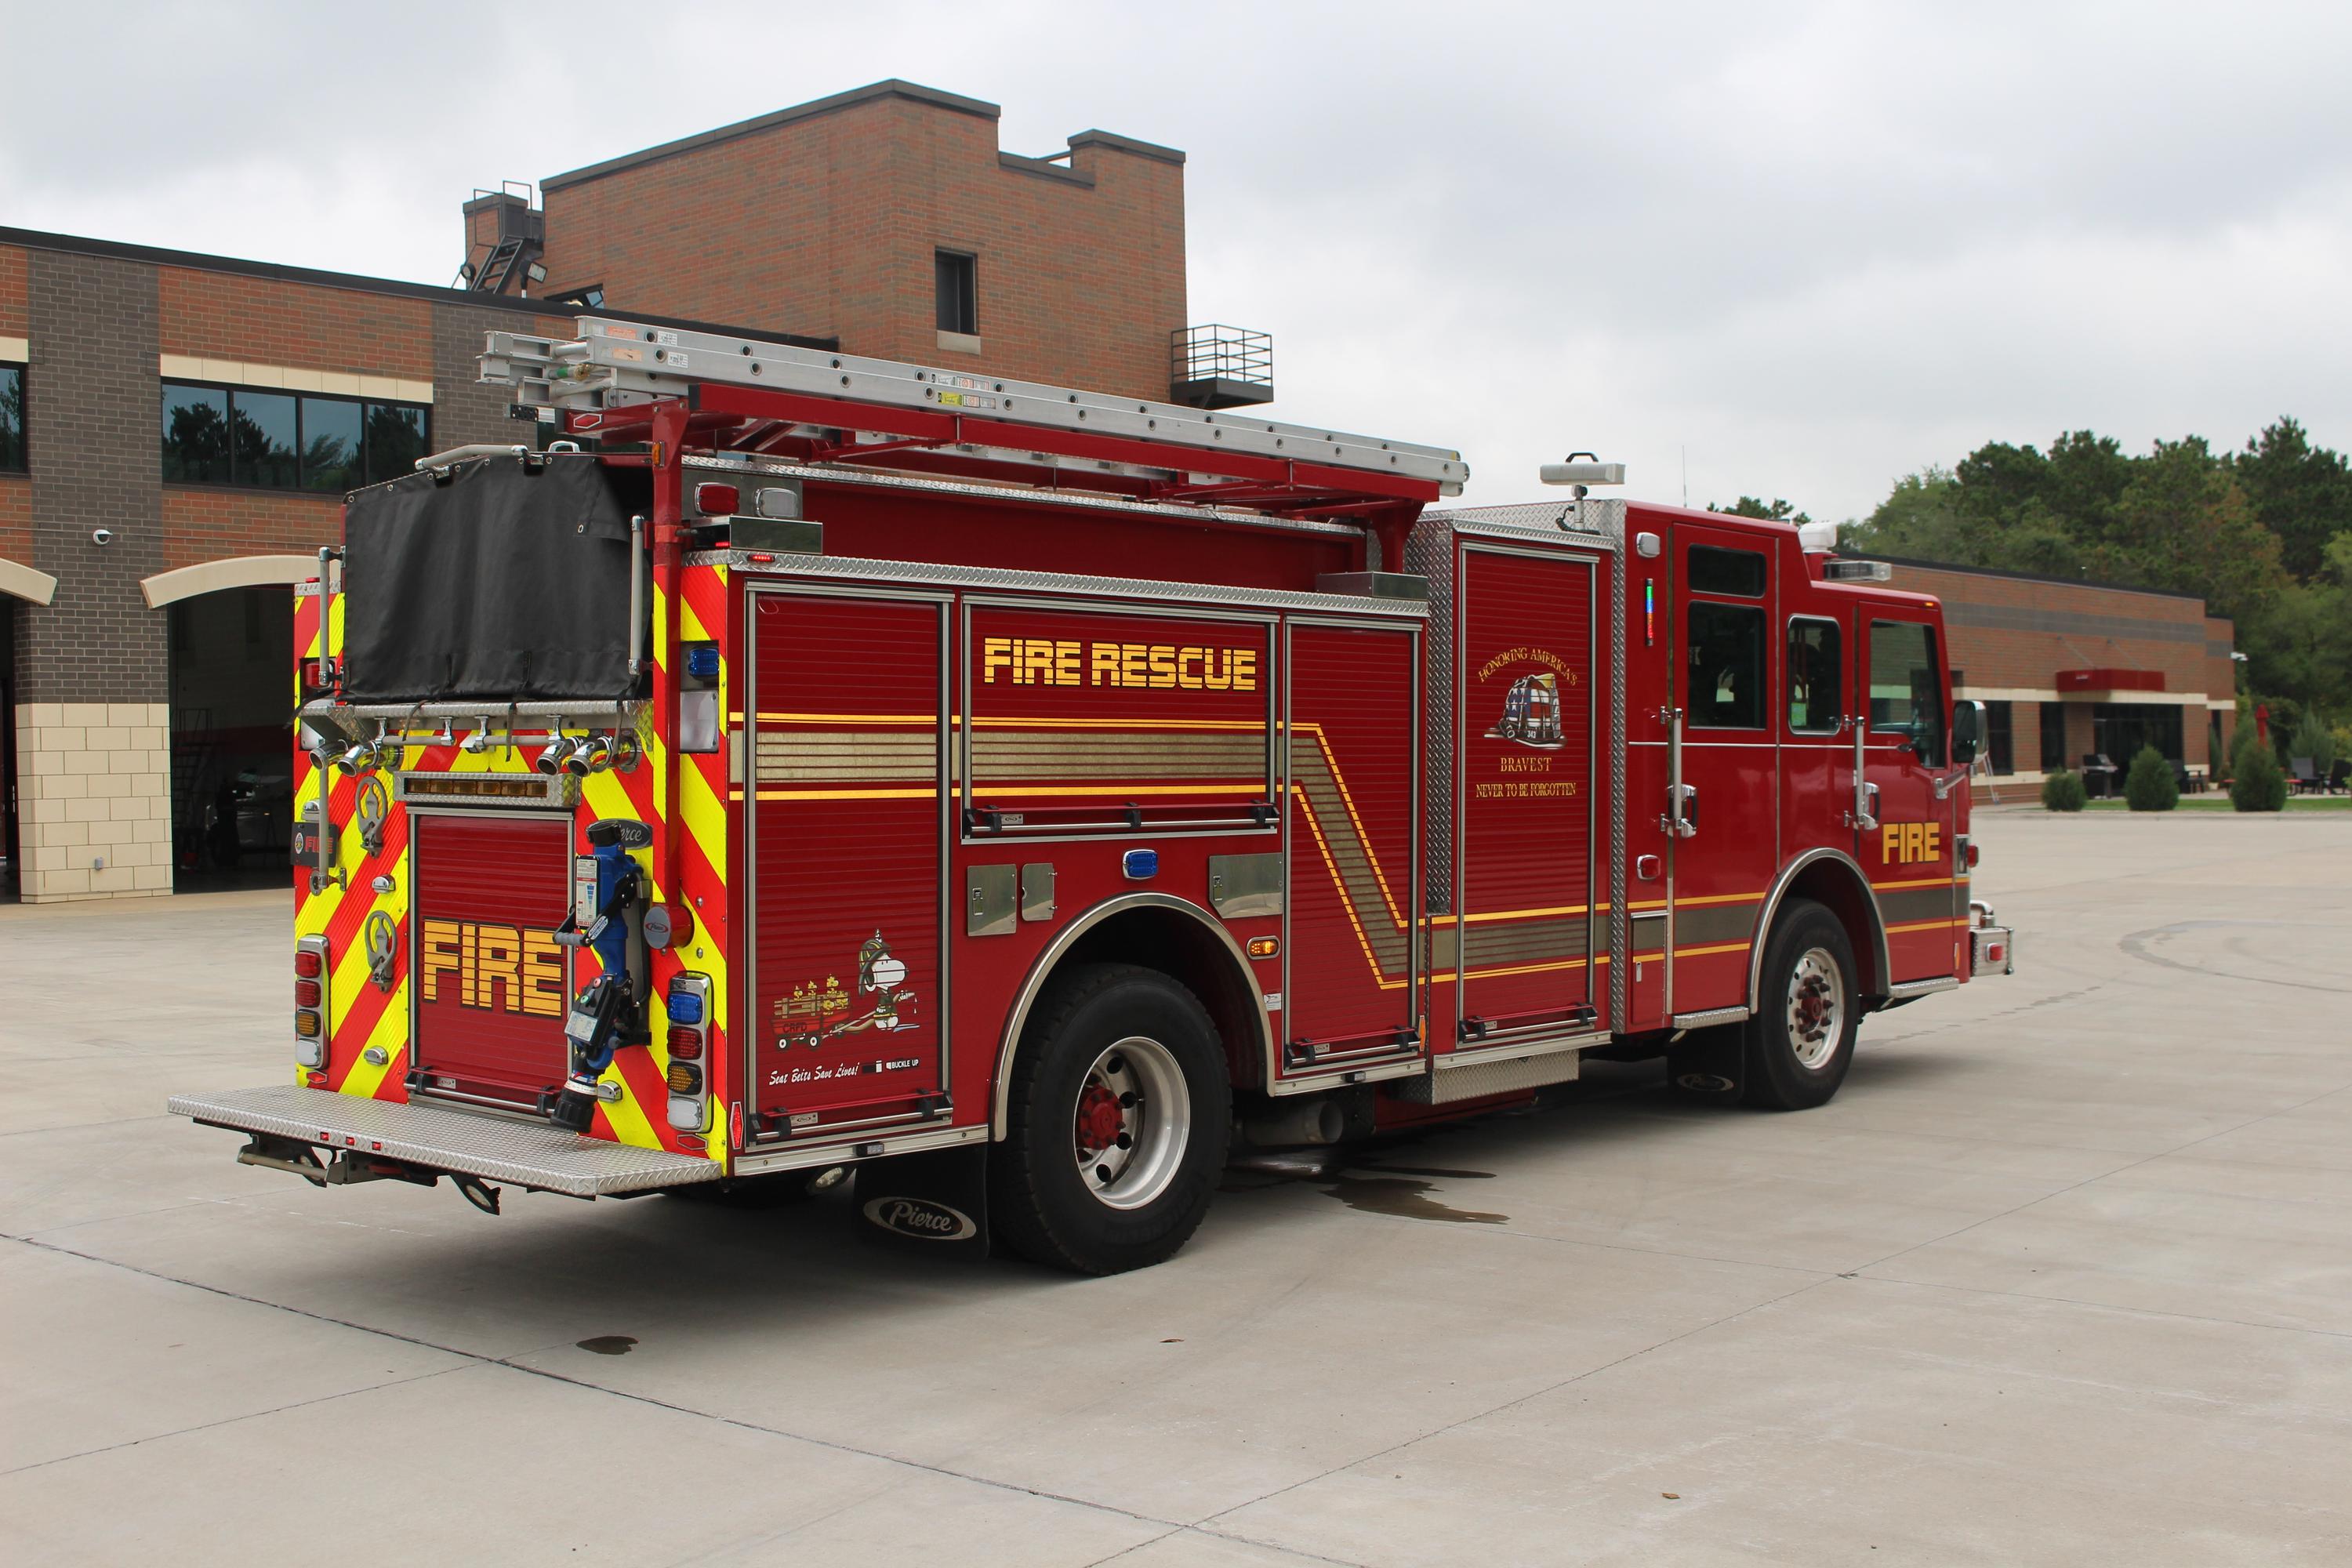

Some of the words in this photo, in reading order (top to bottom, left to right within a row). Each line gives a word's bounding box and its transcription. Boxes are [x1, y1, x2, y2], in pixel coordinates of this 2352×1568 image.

[983, 637, 1081, 686] FIRE
[1091, 641, 1256, 691] RESCUE
[1478, 647, 1528, 684] HONORING
[1530, 648, 1577, 686] AMERICA'S
[1500, 757, 1552, 772] BRAVEST
[1475, 783, 1504, 798] NEVER
[1504, 783, 1517, 797] TO
[1519, 783, 1529, 797] BE
[1530, 782, 1577, 797] FORGOTTEN
[1882, 821, 1940, 865] FIRE
[423, 916, 563, 1018] FIRE
[768, 1069, 789, 1086] Seat
[791, 1068, 811, 1083] Belts
[813, 1065, 833, 1080] Save
[834, 1062, 860, 1078] Lives!
[891, 1059, 910, 1069] BUCKLE
[889, 1201, 953, 1232] Pierce
